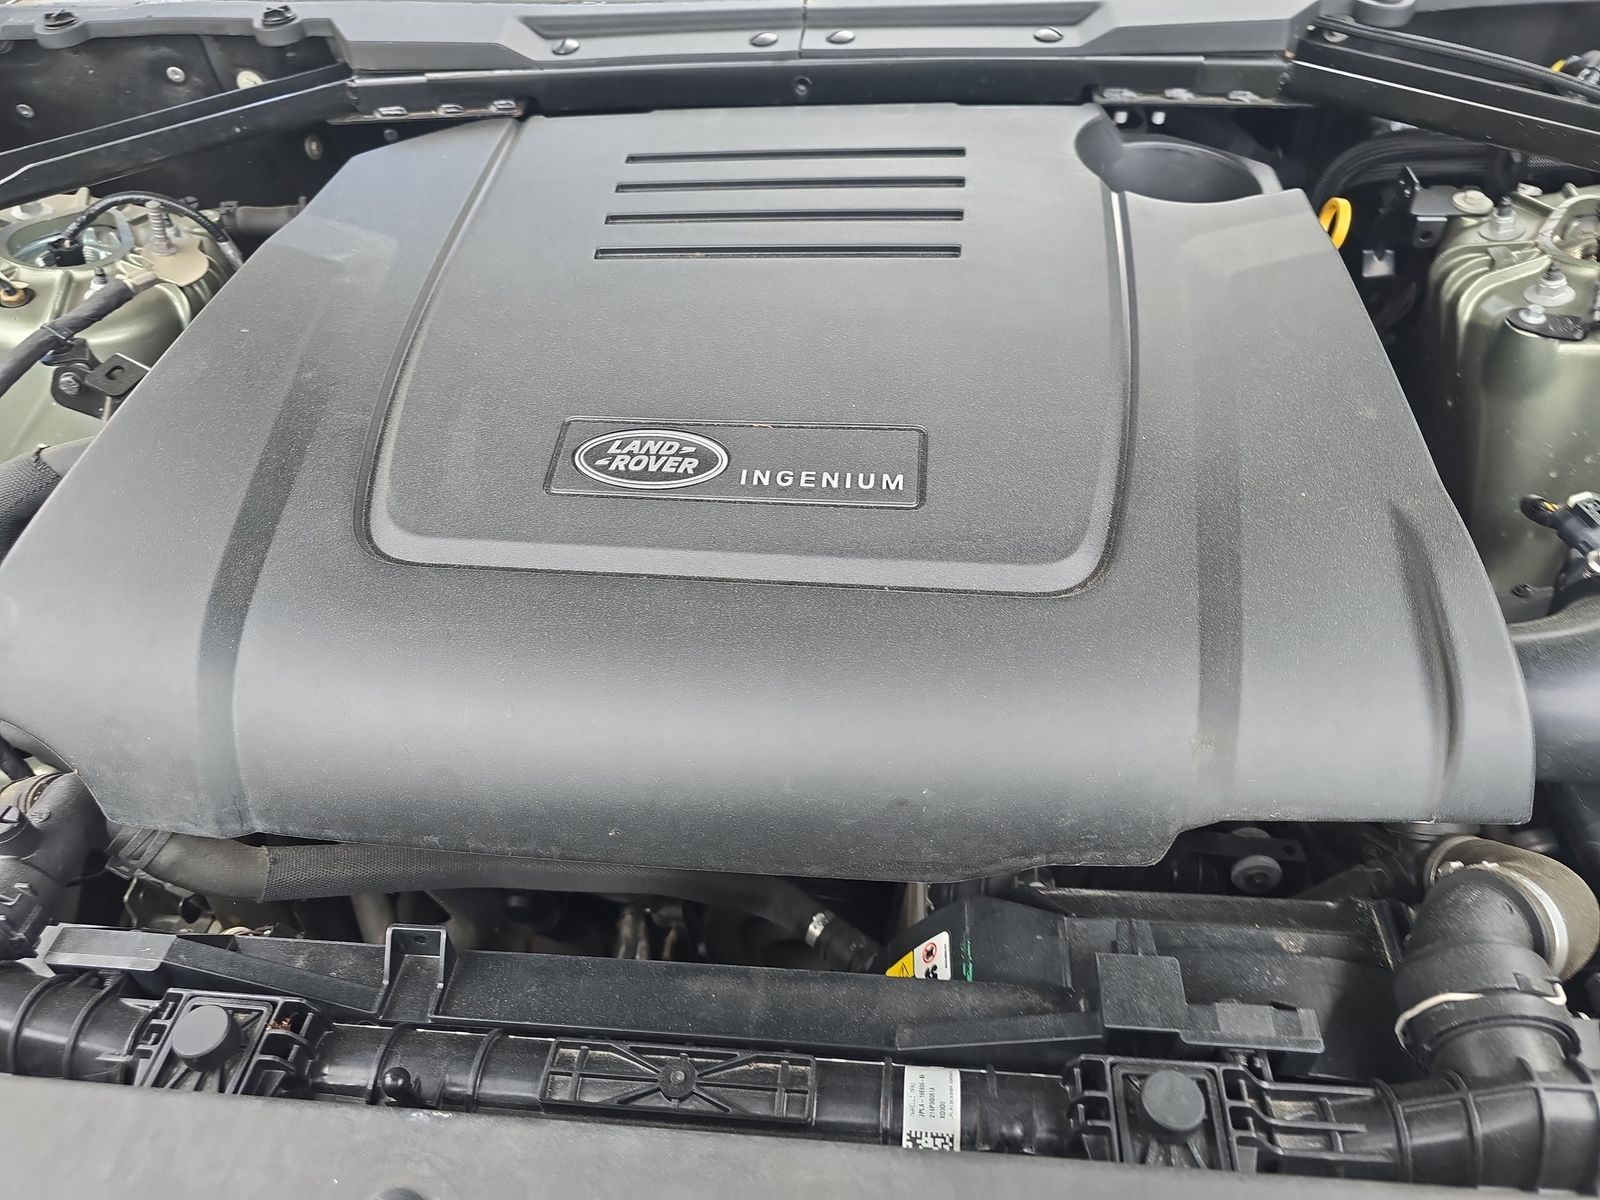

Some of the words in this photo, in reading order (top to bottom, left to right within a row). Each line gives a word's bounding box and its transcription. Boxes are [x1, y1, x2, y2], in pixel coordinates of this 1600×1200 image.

[607, 439, 681, 455] LAND
[608, 455, 700, 474] ROVER
[740, 469, 904, 491] INGENIUM
